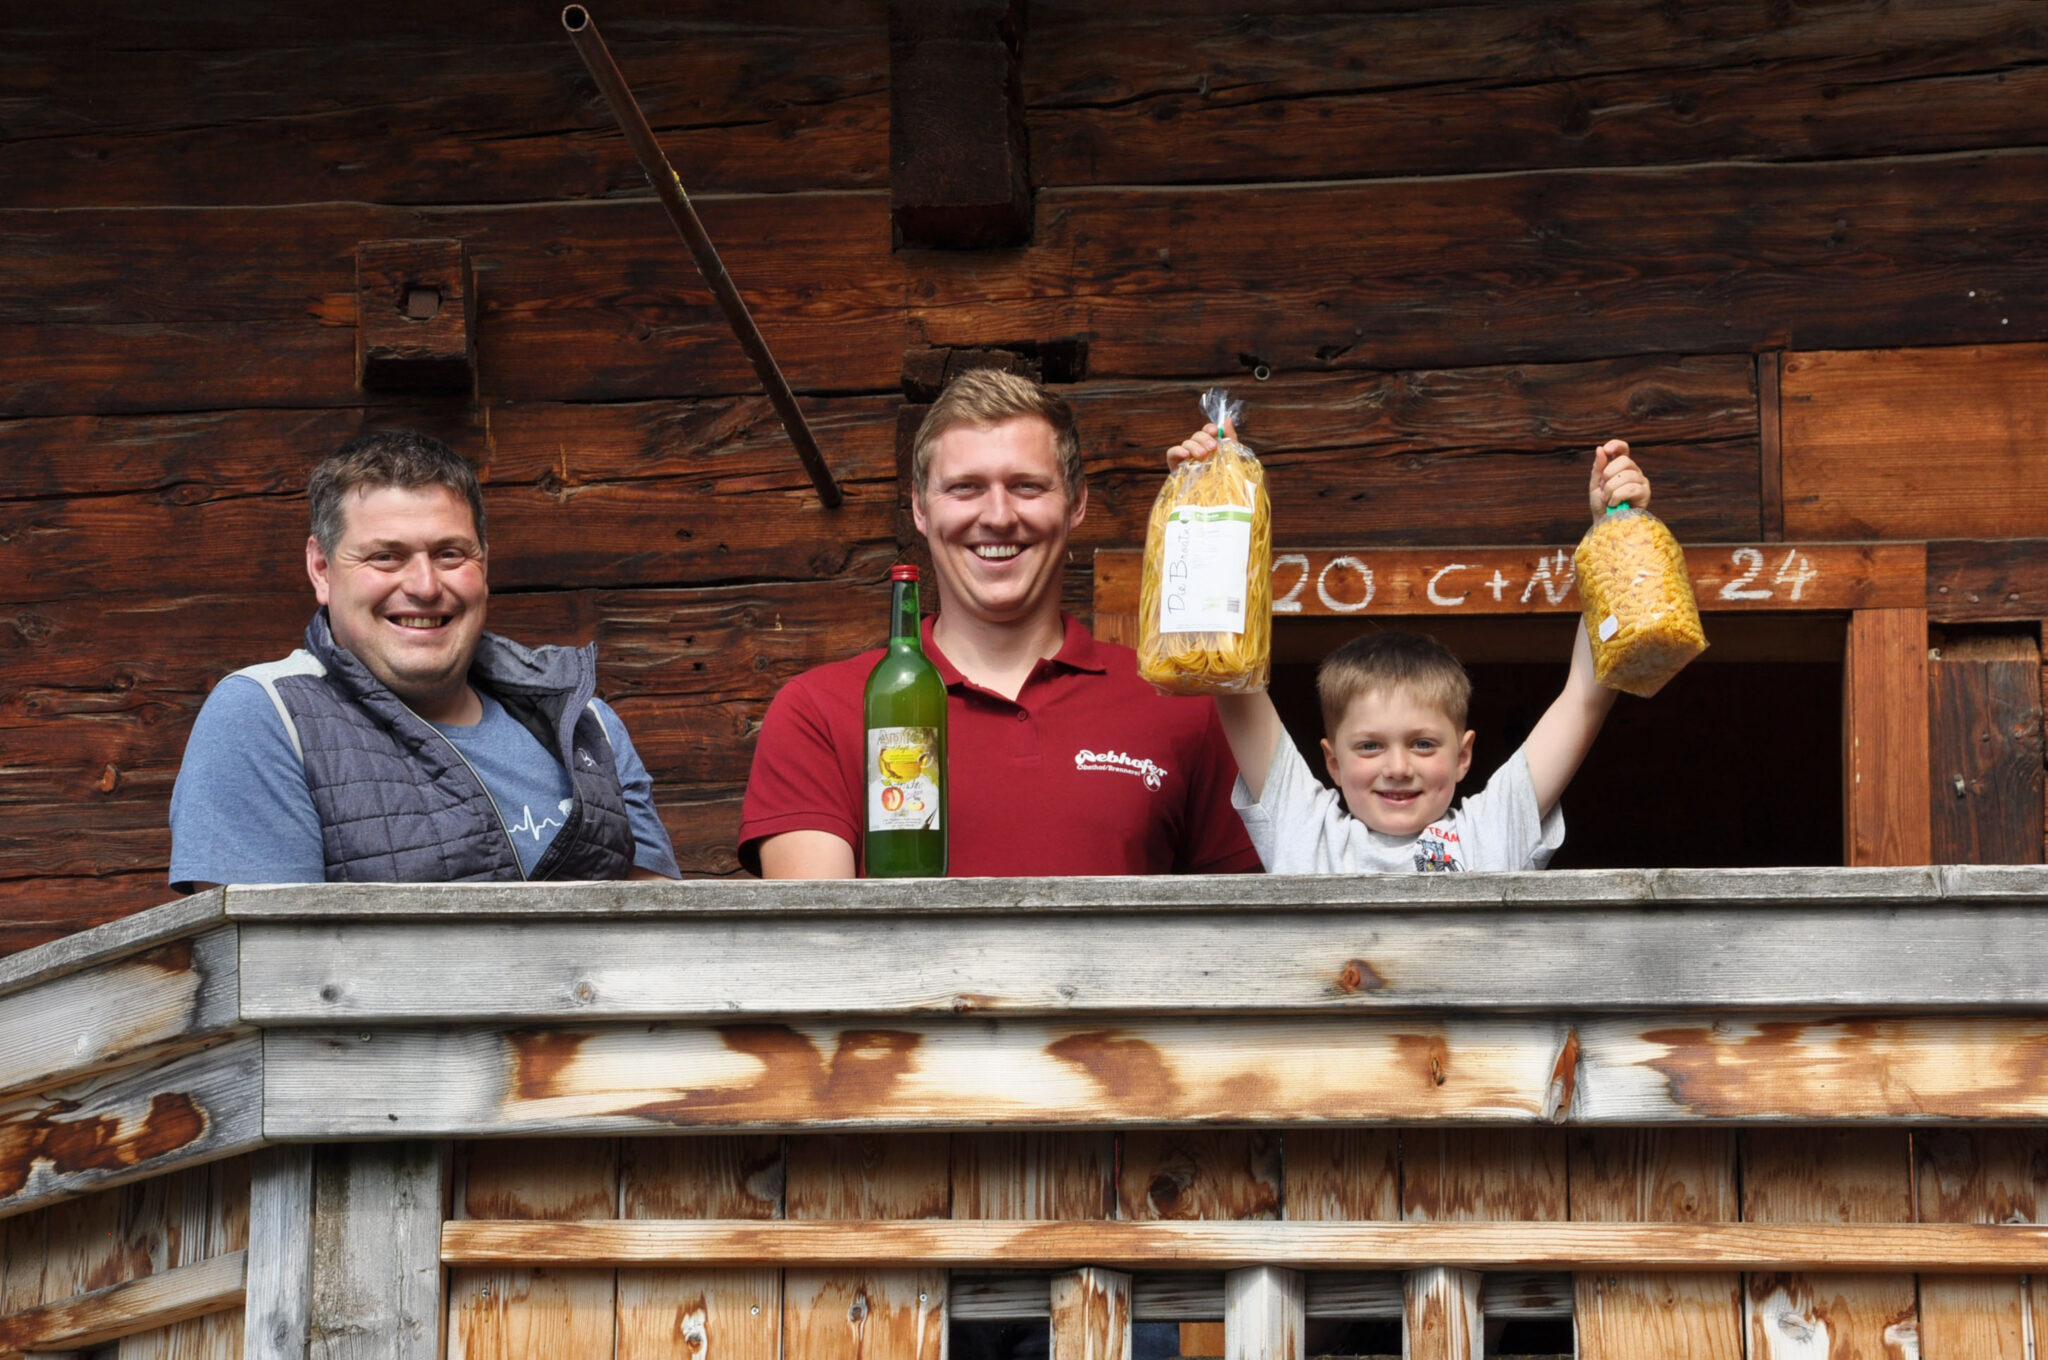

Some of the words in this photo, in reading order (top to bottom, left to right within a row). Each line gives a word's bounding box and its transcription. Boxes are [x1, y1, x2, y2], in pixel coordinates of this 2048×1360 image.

[1272, 554, 1376, 612] 20
[1719, 547, 1818, 602] 24
[1426, 826, 1460, 843] TEAM
